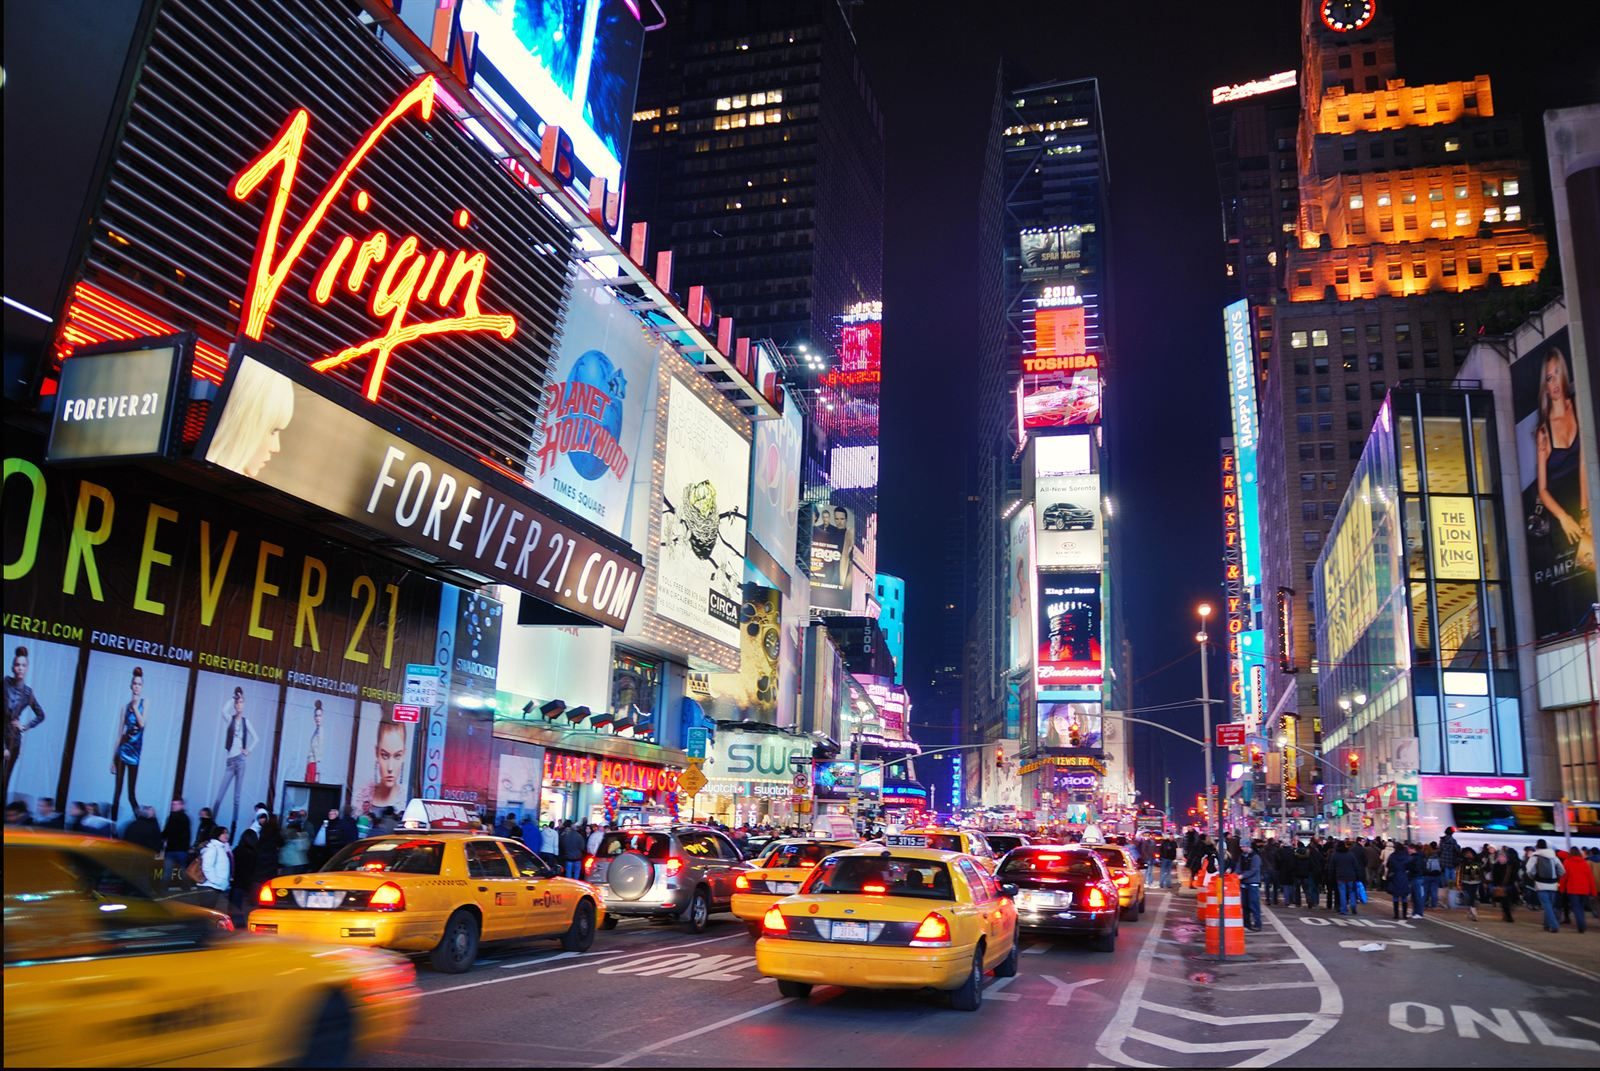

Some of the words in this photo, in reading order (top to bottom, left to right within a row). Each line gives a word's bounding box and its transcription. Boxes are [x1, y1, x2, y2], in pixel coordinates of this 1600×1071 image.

[227, 75, 517, 403] Virgin
[1035, 295, 1084, 308] TOSHIBA
[1043, 285, 1075, 298] 2010
[1023, 354, 1098, 372] TOSHIBA
[1231, 309, 1248, 391] HOLIDAYS
[63, 396, 141, 422] FOREVER
[142, 393, 159, 415] 21
[543, 381, 611, 424] PLANET
[1238, 394, 1253, 448] HAPPY
[536, 416, 630, 480] HOLLYWOOD
[552, 477, 577, 500] TIMES
[577, 490, 606, 518] SQUARE
[1222, 456, 1237, 547] ERNST
[1441, 512, 1466, 525] THE
[1438, 527, 1472, 546] LION
[1440, 548, 1474, 568] KING
[1226, 565, 1240, 580] &
[710, 593, 738, 620] CIRCA
[344, 575, 401, 670] 21
[91, 630, 194, 663] FOREVER21.COM
[199, 651, 283, 681] FOREVER21.COM
[455, 657, 497, 680] SWAROVSKI
[1037, 665, 1103, 678] Budweiser
[287, 669, 359, 696] FOREVER21.COM
[406, 687, 437, 696] SHARED
[431, 629, 452, 738] COMING
[410, 696, 430, 704] LANE
[444, 789, 478, 801] DISCOVER
[754, 785, 790, 796] swatch
[1300, 917, 1417, 930] ONLY
[1388, 1001, 1600, 1054] ONL
